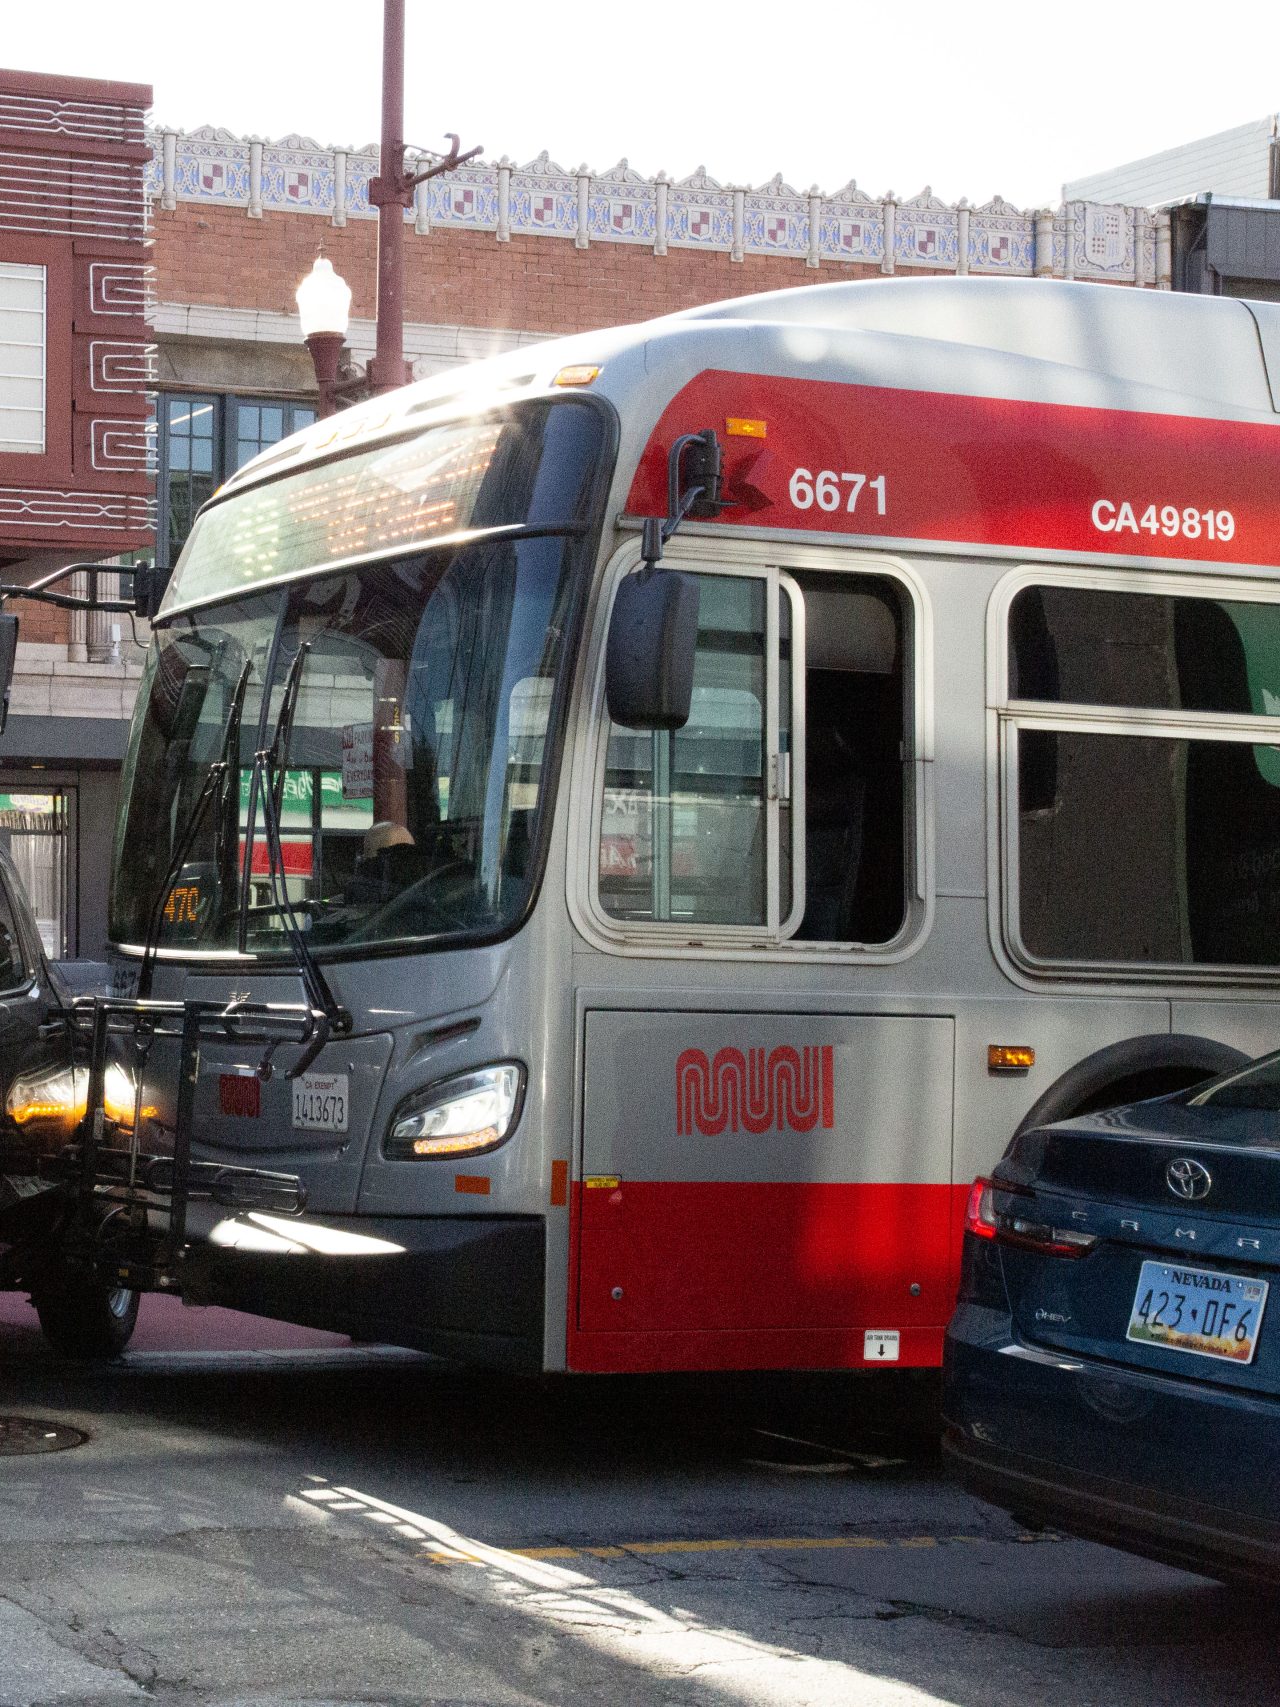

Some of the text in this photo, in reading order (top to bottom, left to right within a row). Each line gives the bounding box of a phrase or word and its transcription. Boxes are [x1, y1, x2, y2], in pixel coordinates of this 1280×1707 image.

[789, 468, 887, 515] 6671
[1091, 499, 1235, 542] CA49819
[305, 1081, 334, 1090] CA EXEMPT
[295, 1094, 344, 1123] 1413673
[1171, 1270, 1231, 1293] NEVADA
